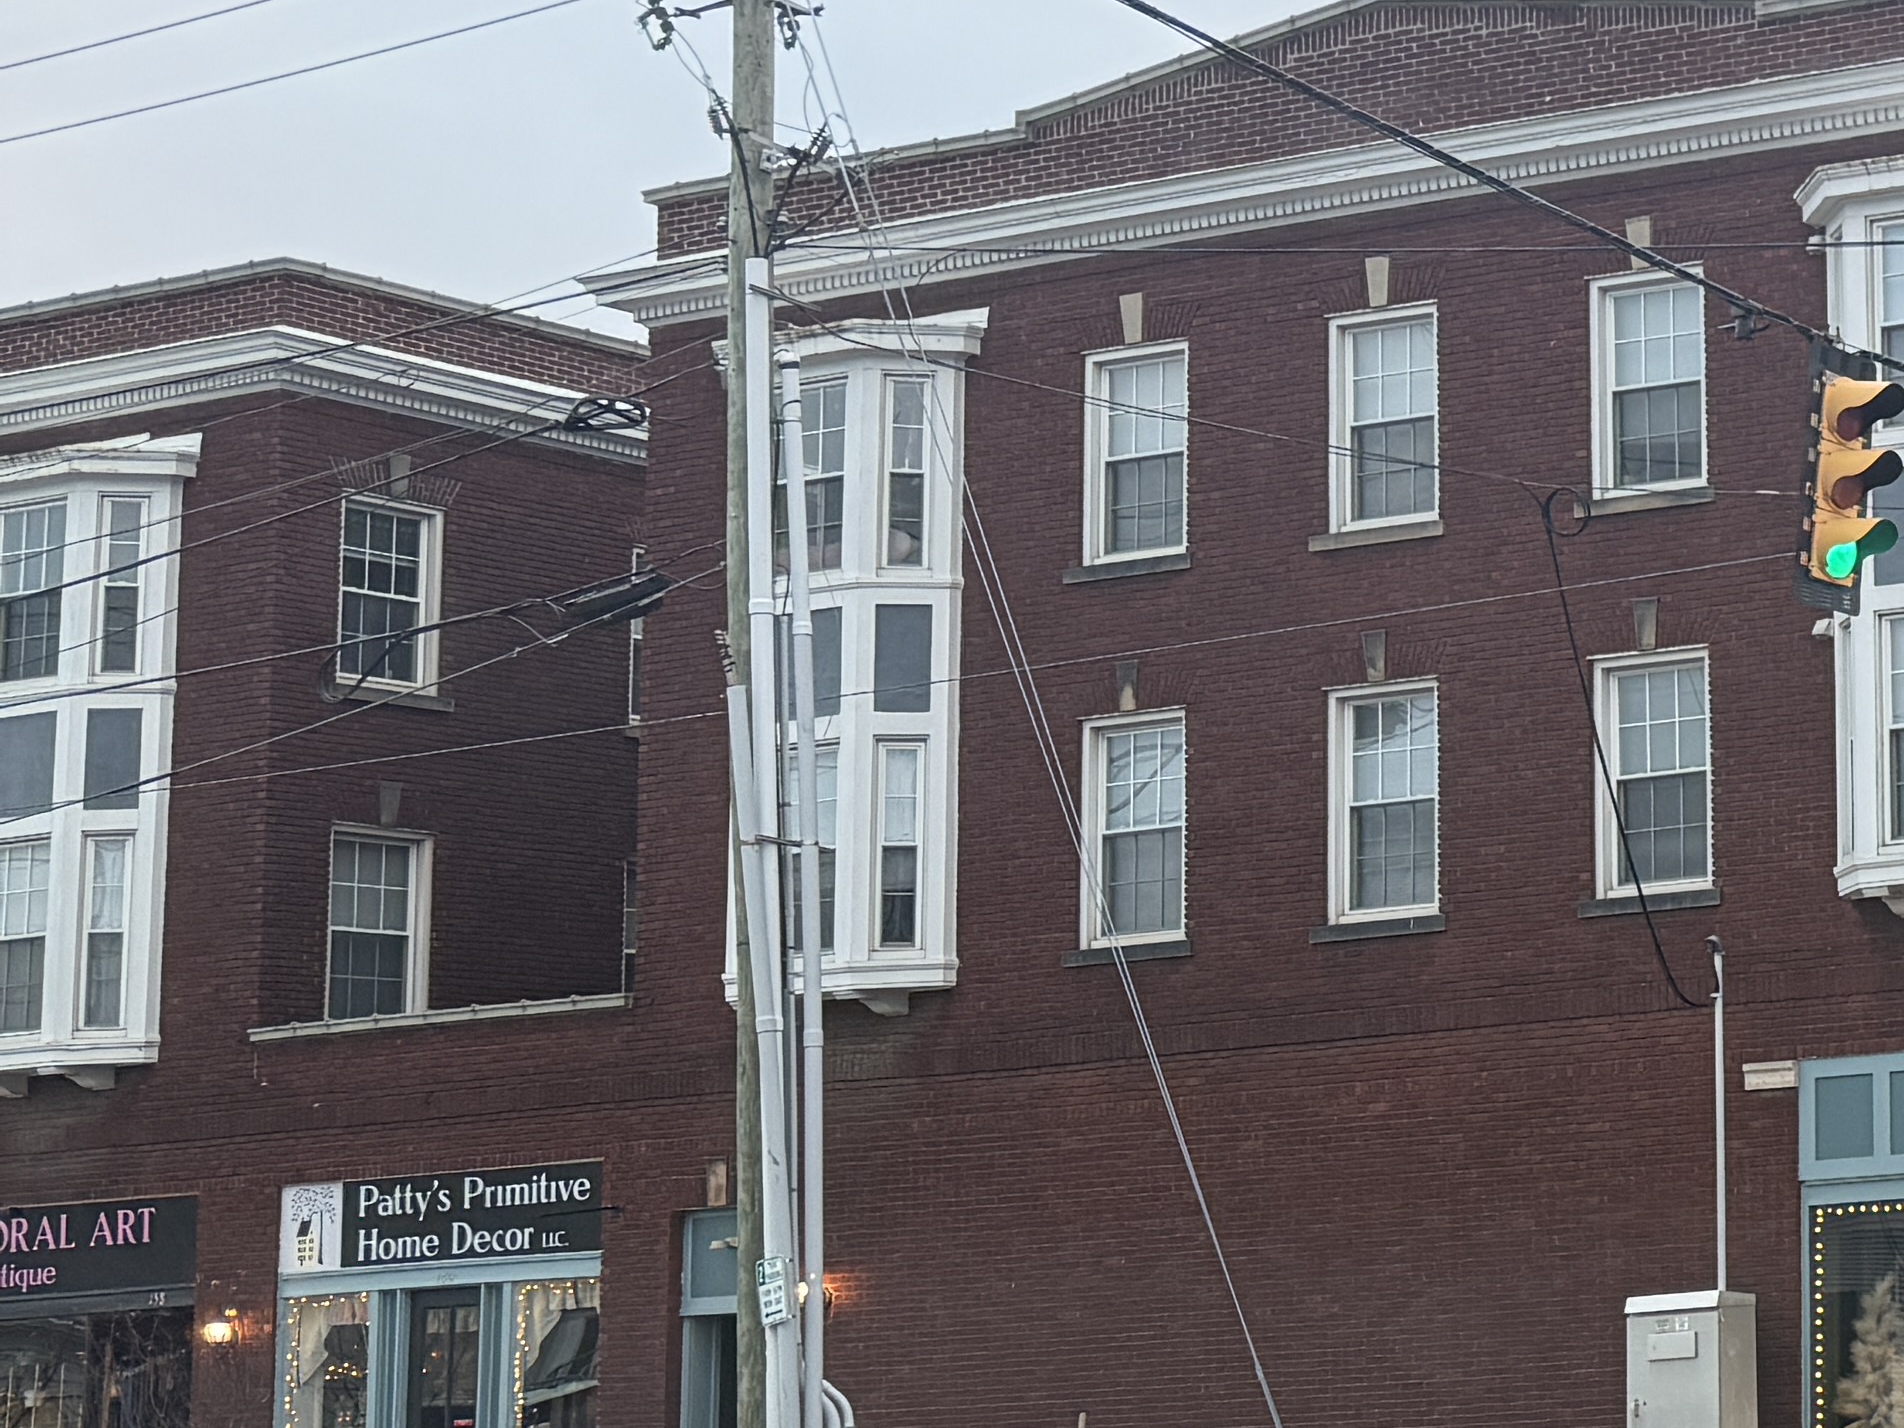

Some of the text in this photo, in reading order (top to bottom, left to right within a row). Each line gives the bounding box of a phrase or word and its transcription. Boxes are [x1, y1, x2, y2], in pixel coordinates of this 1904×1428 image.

[358, 1172, 591, 1221] Patty's Primitive
[90, 1207, 156, 1247] ART
[357, 1229, 440, 1262] Home
[451, 1222, 534, 1255] Decor
